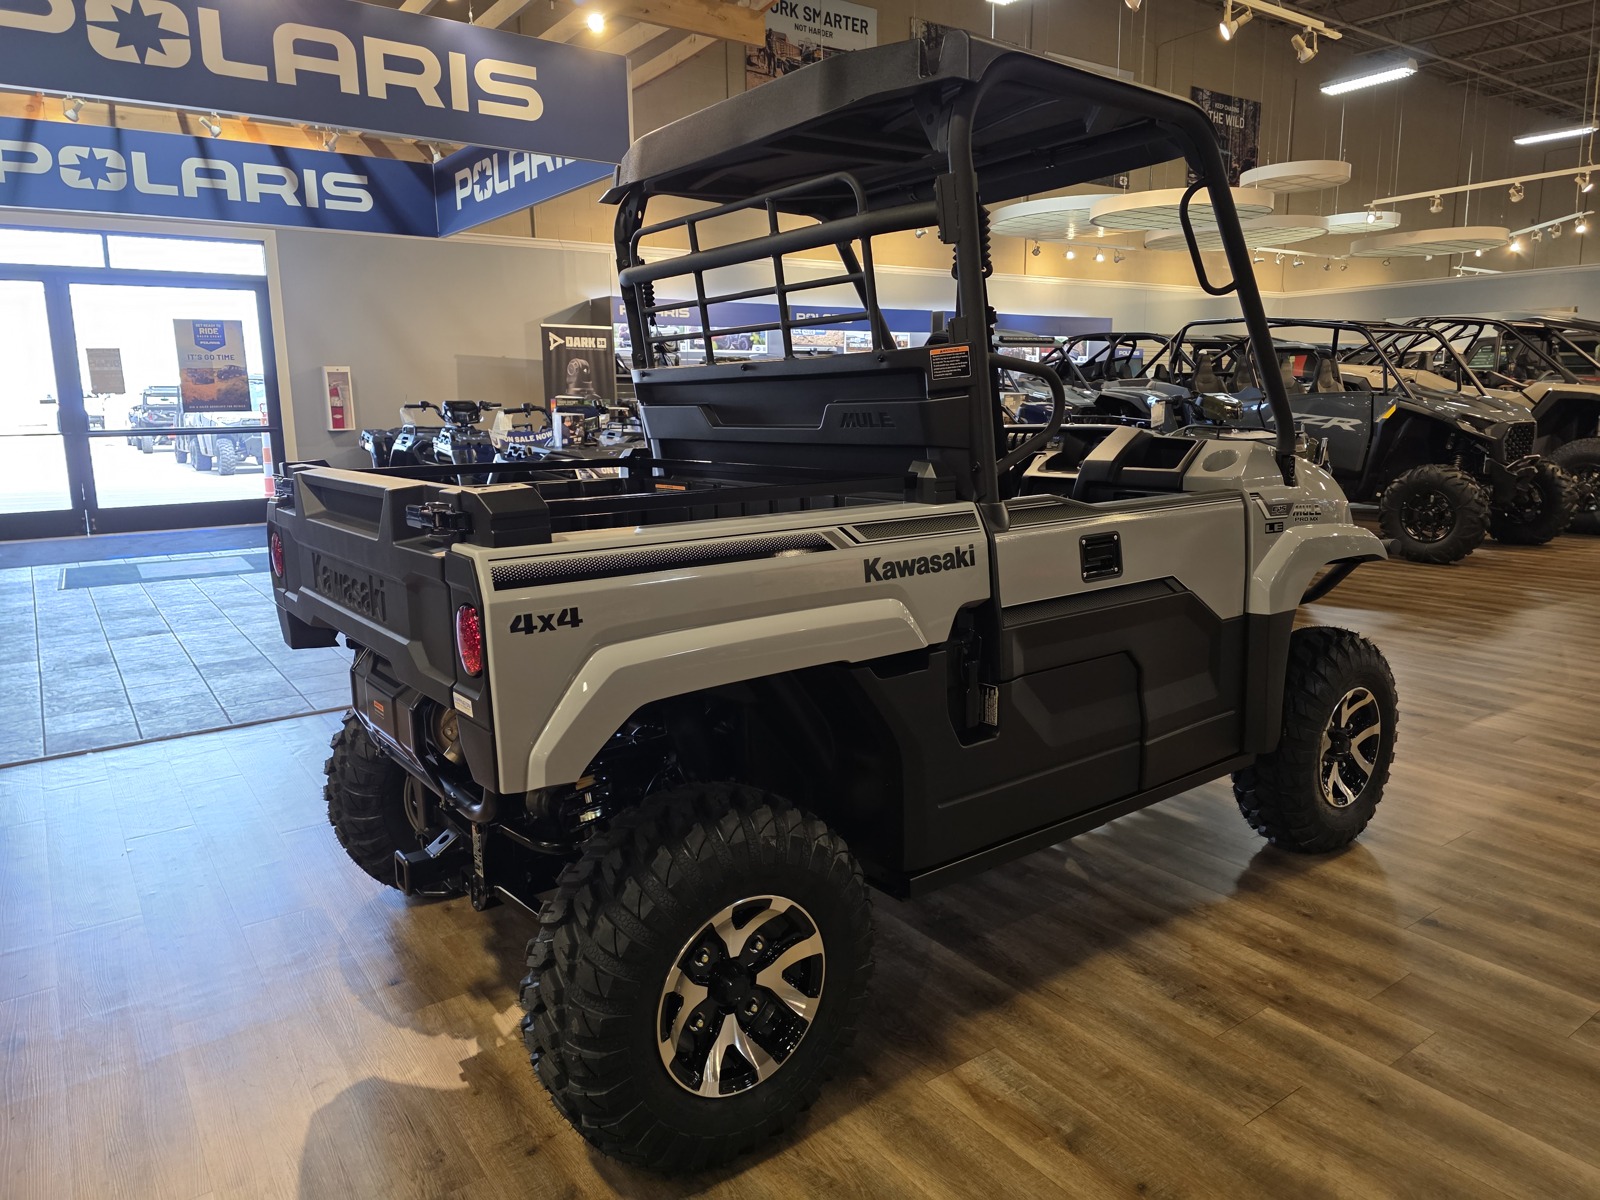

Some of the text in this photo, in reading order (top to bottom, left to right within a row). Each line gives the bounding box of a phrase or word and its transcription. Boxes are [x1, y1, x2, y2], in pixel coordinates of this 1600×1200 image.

[803, 5, 869, 36] SMARTER
[794, 23, 834, 39] NOT HARDER
[1208, 110, 1245, 129] THE WILD
[0, 139, 374, 212] POLARIS
[565, 336, 596, 348] DARK
[840, 412, 897, 428] MULE
[514, 433, 535, 444] SALE
[535, 430, 553, 441] NOW
[1265, 522, 1283, 534] LE
[863, 544, 976, 583] Kawasaki
[312, 552, 387, 623] Kawasaki
[509, 607, 583, 635] 4x4
